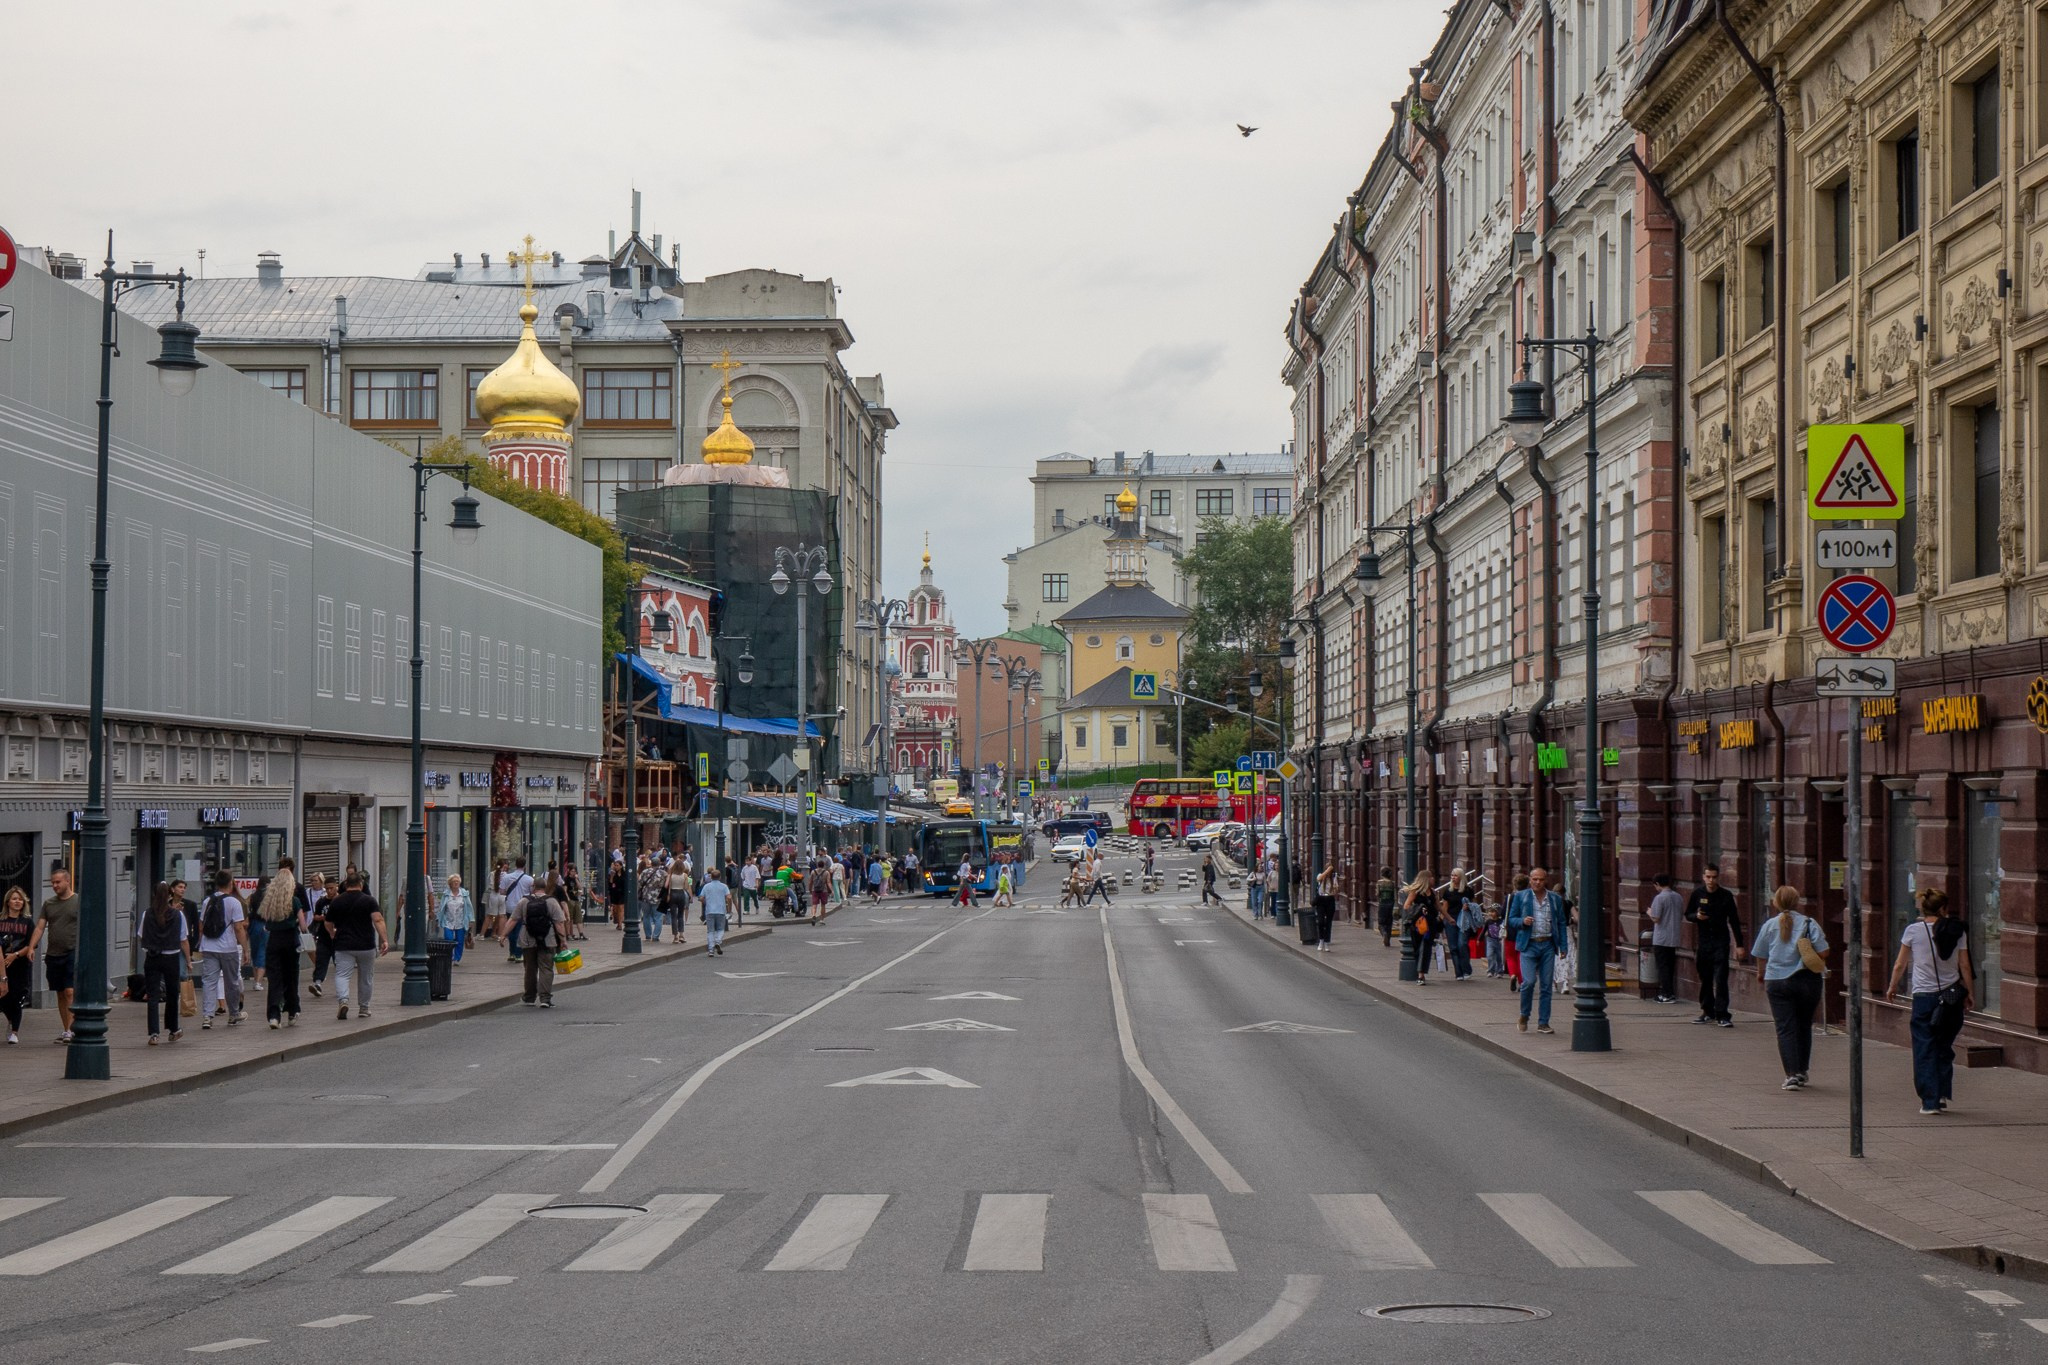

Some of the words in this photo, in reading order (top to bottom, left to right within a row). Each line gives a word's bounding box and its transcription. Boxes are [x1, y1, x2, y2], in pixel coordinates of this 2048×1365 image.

[1922, 695, 1980, 735] ВАРЕНИЧНАЯ
[1720, 719, 1755, 749] ВАРЕНИЧНАЯ
[1866, 724, 1883, 743] КАФЕ
[203, 807, 219, 824] СИДР
[219, 807, 225, 822] &
[225, 807, 240, 822] ПИВО
[235, 880, 258, 889] ТАБА
